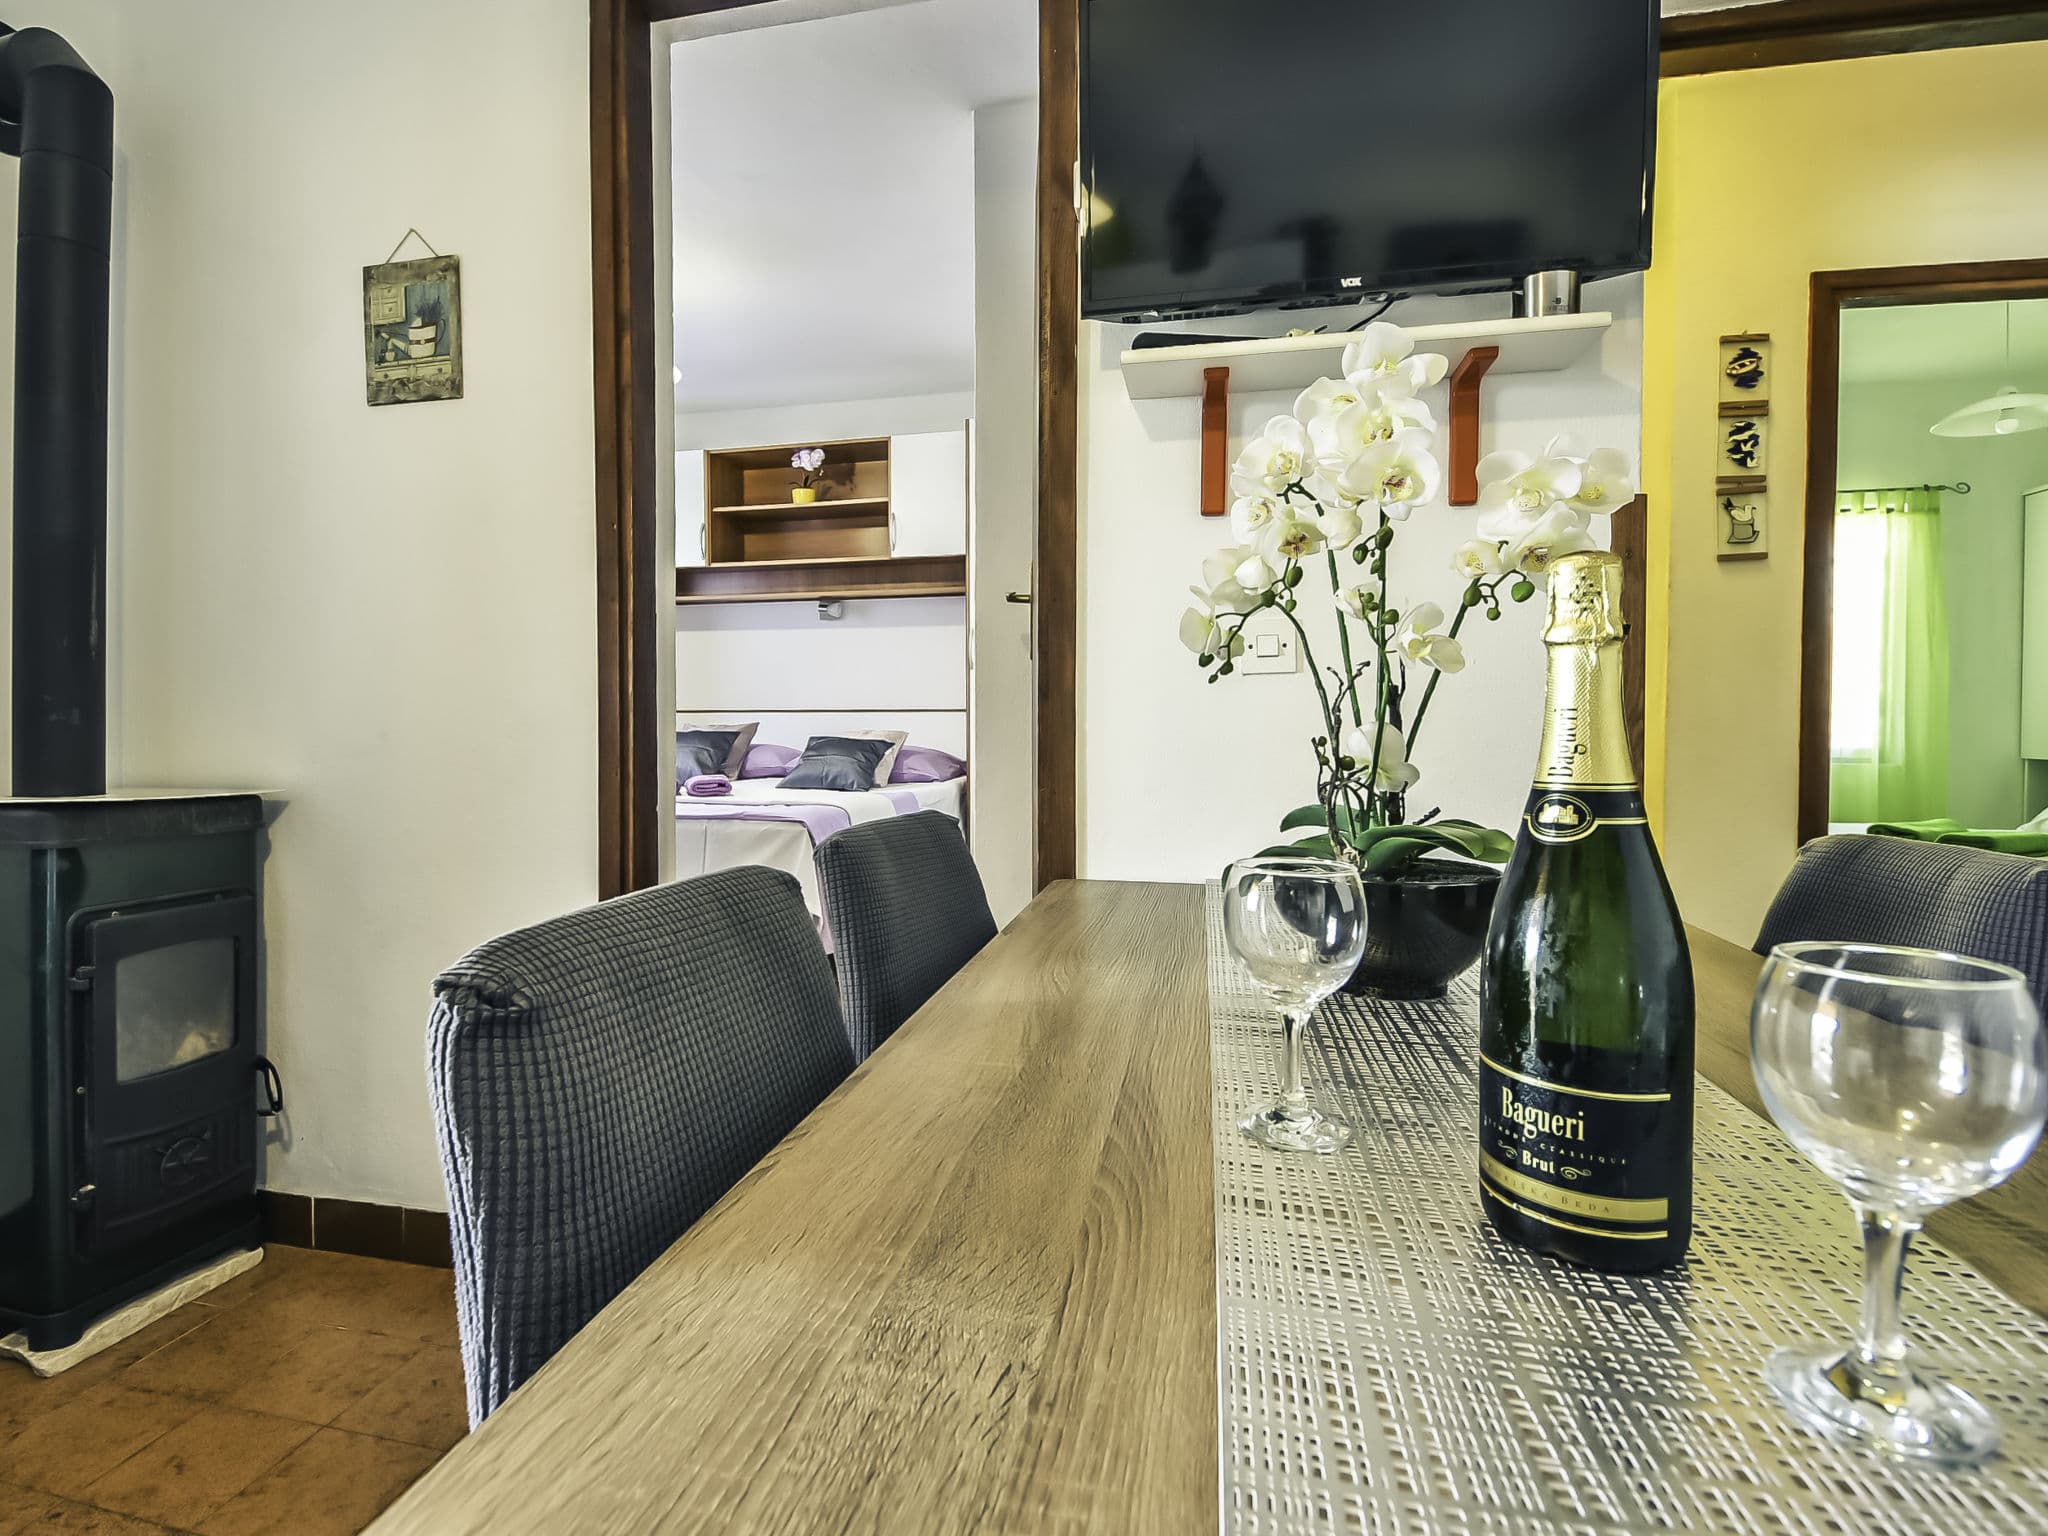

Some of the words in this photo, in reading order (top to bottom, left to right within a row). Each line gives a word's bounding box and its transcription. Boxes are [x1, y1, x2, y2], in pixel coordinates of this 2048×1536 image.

[1340, 276, 1362, 288] VOX
[1502, 1086, 1585, 1142] Bagueri
[1522, 1149, 1556, 1175] Brut
